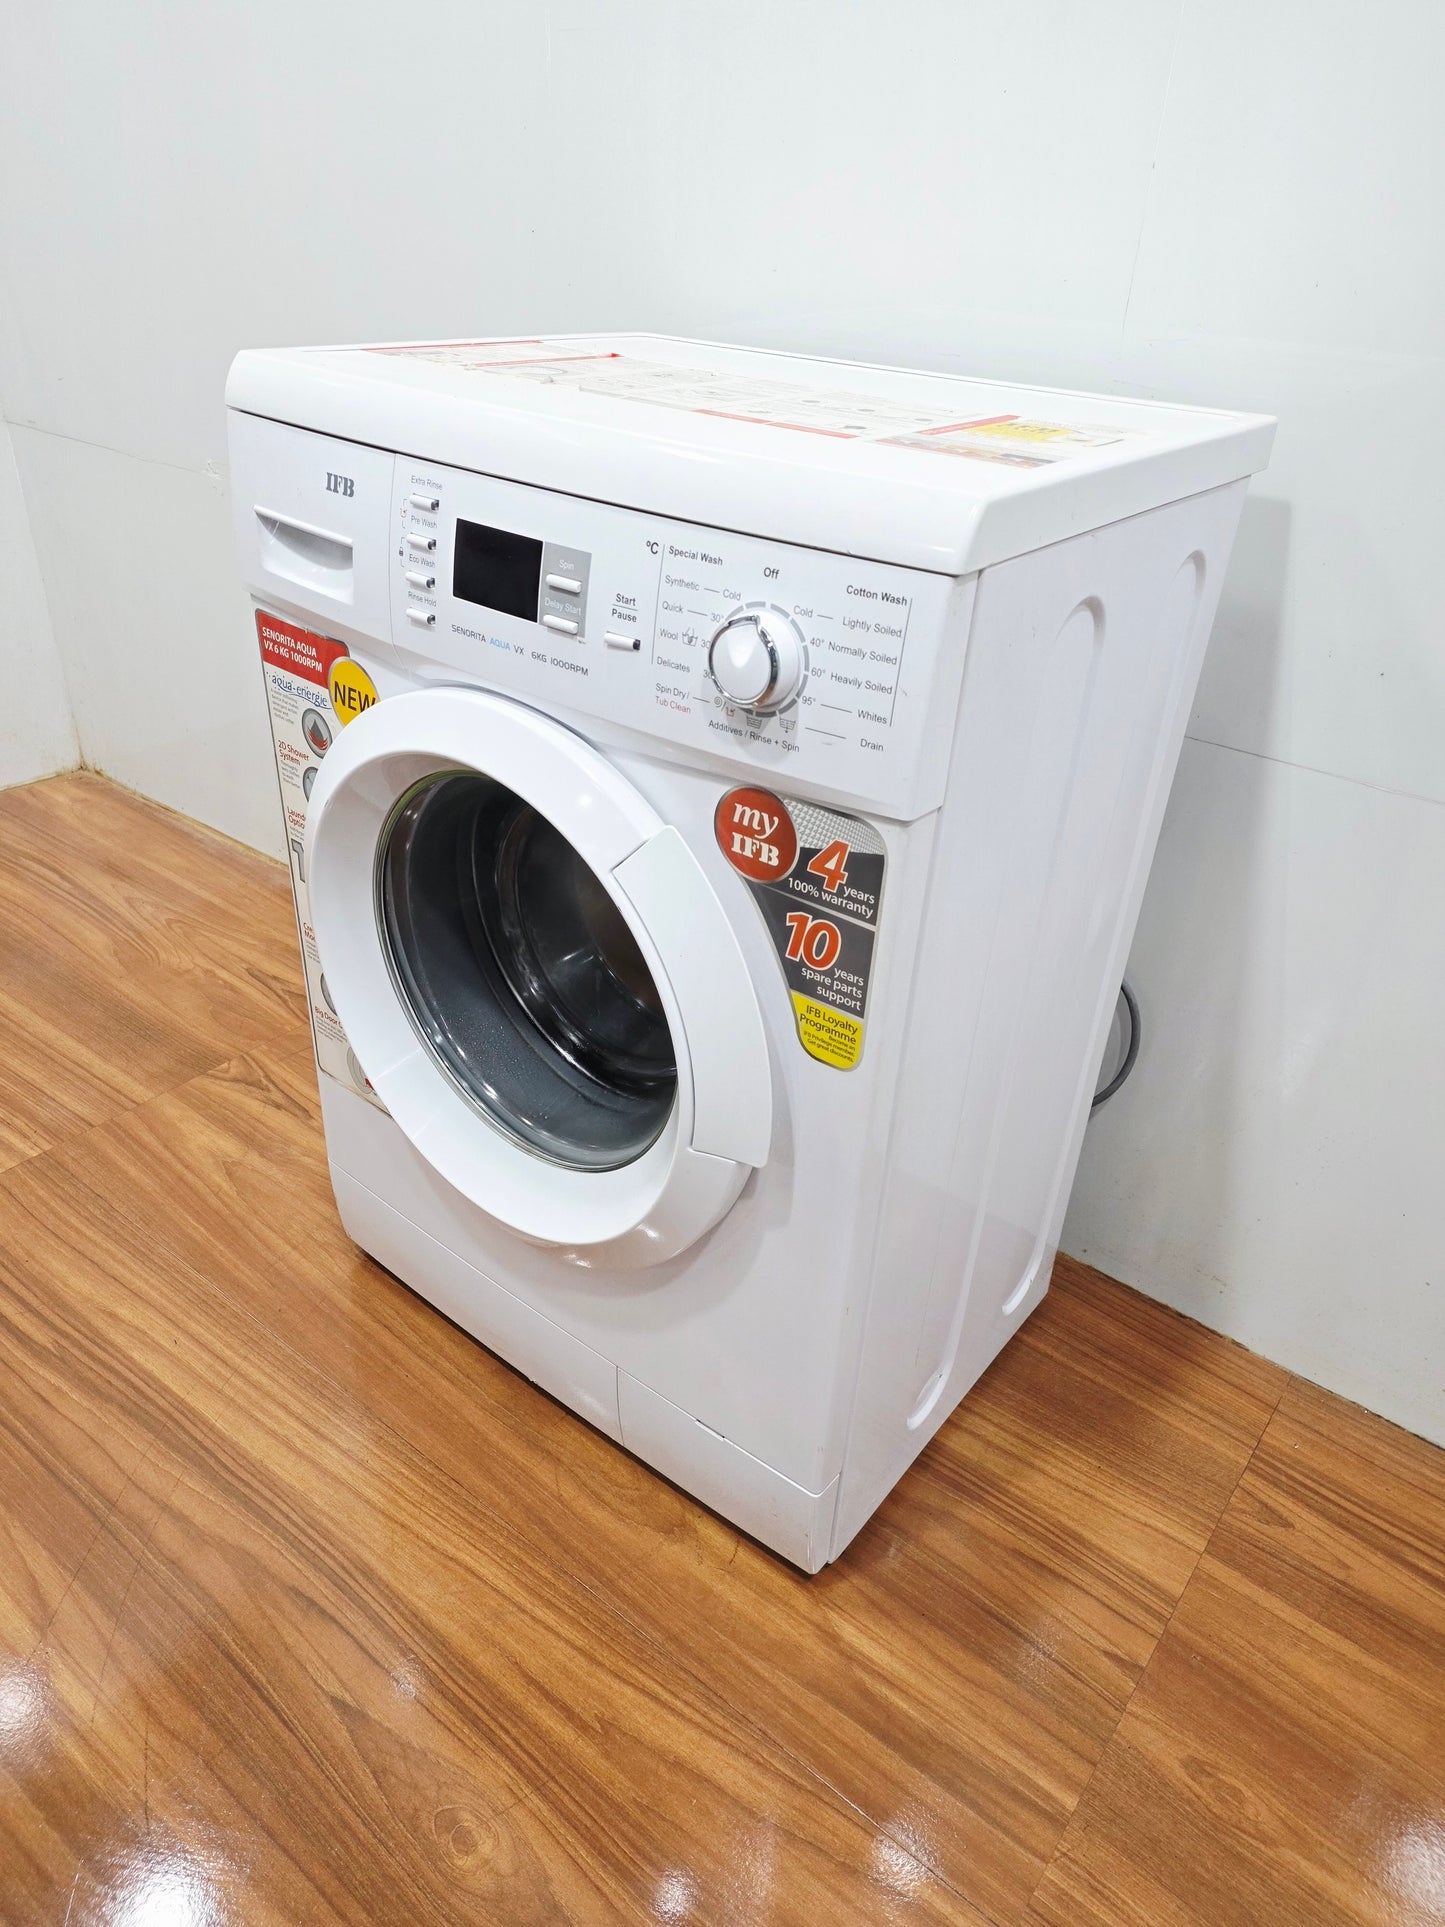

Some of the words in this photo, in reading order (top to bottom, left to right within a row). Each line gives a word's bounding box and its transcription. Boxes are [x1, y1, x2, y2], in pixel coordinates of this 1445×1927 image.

[326, 472, 355, 498] IFB
[411, 475, 425, 486] Extra
[426, 478, 443, 491] Rinse
[411, 515, 421, 526] Pre
[422, 518, 438, 529] Wash
[409, 553, 420, 564] Eco
[421, 556, 436, 568] Wash
[559, 560, 575, 571] Spin
[669, 545, 698, 560] Special
[700, 552, 723, 566] Wash
[763, 567, 780, 580] Off
[408, 591, 423, 602] Rinse
[424, 595, 437, 607] Hold
[615, 593, 636, 606] Start
[665, 575, 700, 591] Synthetic
[722, 588, 742, 602] Cold
[846, 584, 878, 600] Cotton
[881, 592, 908, 606] Wash
[544, 597, 563, 612] Delay
[565, 602, 582, 616] Start
[611, 608, 637, 623] Pause
[662, 601, 684, 614] Quick
[793, 605, 813, 618] Cold
[842, 616, 871, 633] Lightly
[874, 624, 902, 638] Soiled
[262, 626, 296, 649] SENORITA
[296, 642, 317, 658] AQUA
[451, 624, 486, 643] SENORITA
[490, 637, 510, 651] AQUA
[513, 645, 524, 656] VX
[531, 651, 547, 663] 6KG
[550, 657, 589, 676] 1000RPM
[659, 628, 679, 640] Wool
[701, 638, 712, 650] 30
[810, 637, 825, 648] 40°
[828, 641, 867, 660] Normally
[869, 652, 898, 665] Soiled
[264, 640, 274, 653] VX
[274, 644, 279, 655] 6
[280, 647, 290, 659] KG
[291, 651, 323, 673] 1000RPM
[656, 656, 690, 673] Delicates
[703, 669, 712, 680] 30
[655, 683, 672, 695] Spin
[811, 667, 825, 678] 60°
[830, 672, 862, 689] Heavily
[865, 681, 893, 695] Soiled
[334, 681, 376, 713] NEW
[655, 695, 668, 707] Tub
[670, 701, 691, 714] Clean
[858, 710, 888, 725] Whites
[708, 719, 743, 737] Additives
[750, 731, 772, 745] Rinse
[781, 740, 800, 753] Spin
[860, 738, 884, 751] Drain
[278, 740, 287, 751] 2D
[288, 744, 309, 761] Shower
[279, 749, 300, 766] System
[734, 802, 779, 839] my
[731, 831, 780, 867] IFB
[807, 839, 850, 893] 4
[843, 884, 875, 904] years
[788, 877, 819, 898] 100%
[821, 891, 874, 920] warranty
[785, 911, 842, 971] 10
[834, 966, 864, 986] years
[801, 966, 832, 987] spare
[833, 980, 863, 999] parts
[816, 986, 862, 1011] support
[800, 1013, 856, 1045] Programme
[806, 1005, 821, 1018] IFB
[823, 1011, 858, 1035] Loyalty
